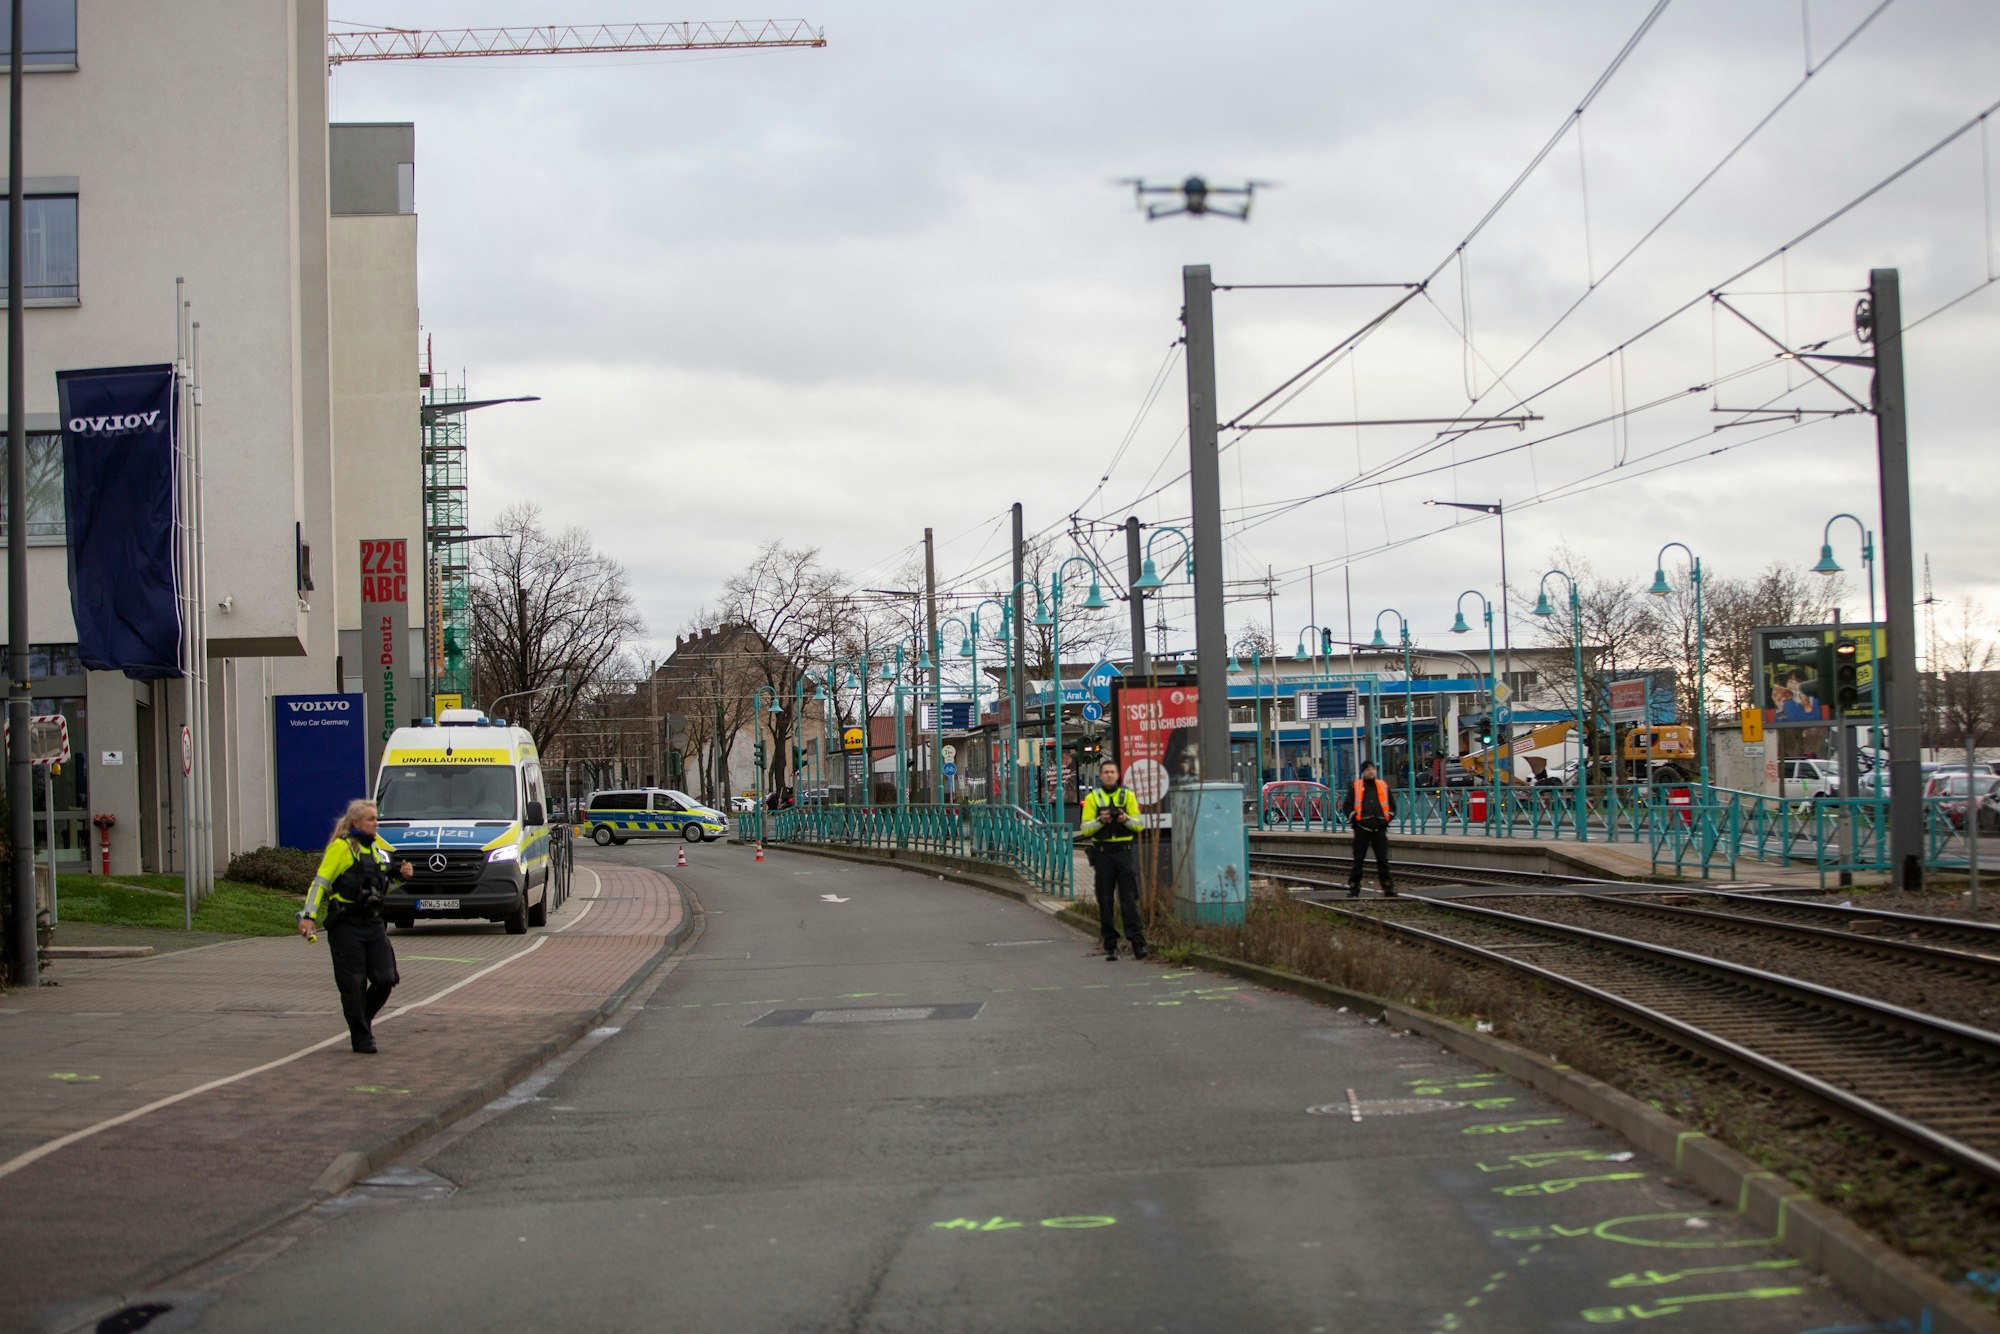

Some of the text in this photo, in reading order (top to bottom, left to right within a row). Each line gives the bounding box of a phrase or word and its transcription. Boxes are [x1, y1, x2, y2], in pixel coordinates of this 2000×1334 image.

[361, 541, 406, 574] 229
[363, 575, 407, 603] ABC
[287, 701, 350, 712] VOLVO
[321, 719, 350, 727] Germany
[402, 830, 474, 838] POLIZEI
